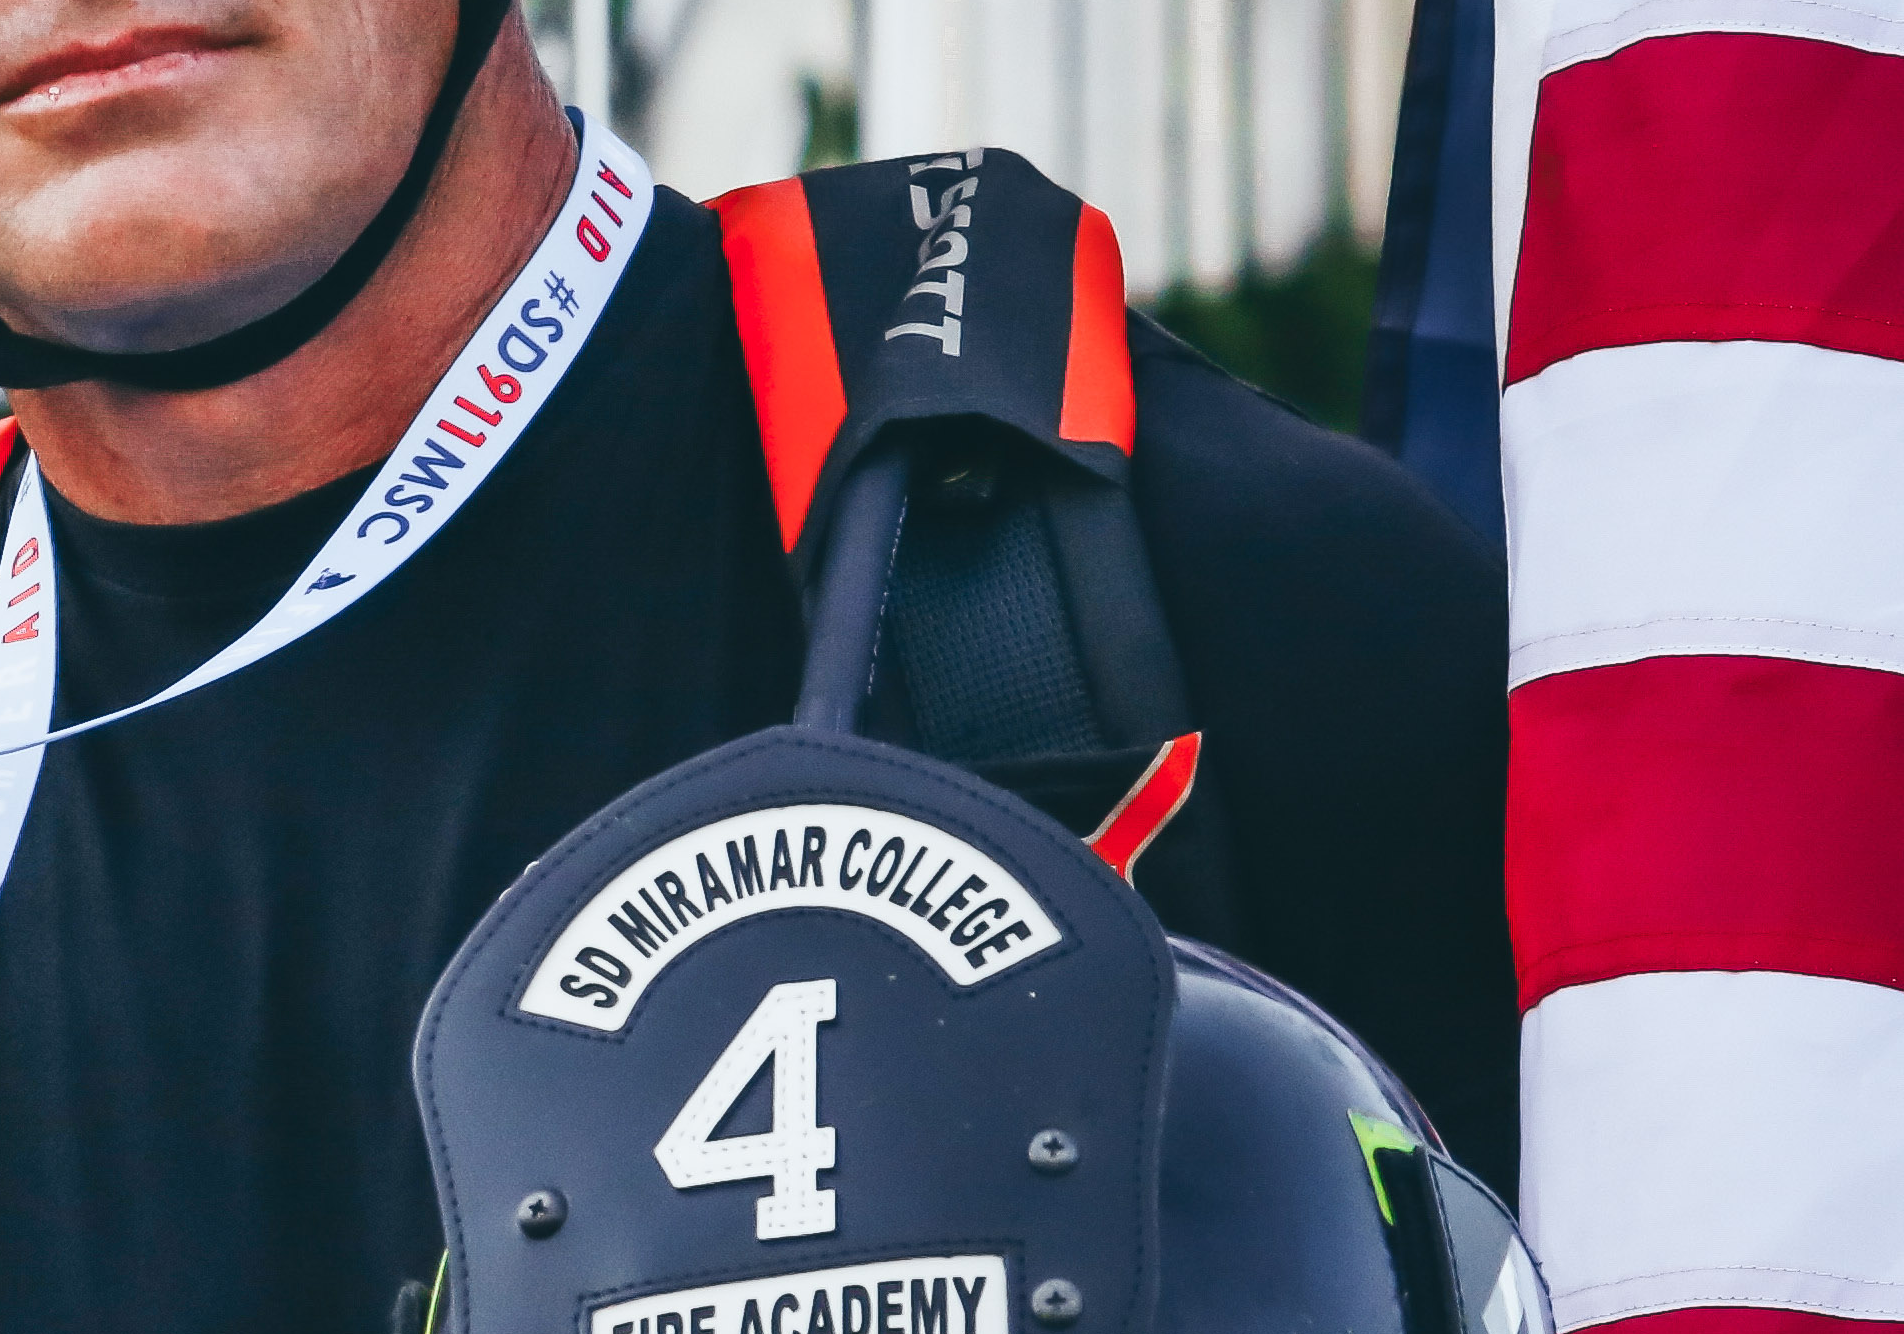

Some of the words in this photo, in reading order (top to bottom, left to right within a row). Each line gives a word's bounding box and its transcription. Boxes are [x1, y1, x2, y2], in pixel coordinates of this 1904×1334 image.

[576, 159, 635, 263] AID
[356, 268, 583, 546] #SD911MSC
[1, 535, 42, 645] AID
[559, 944, 633, 1009] SD
[607, 825, 830, 960] MIRAMAR
[839, 829, 1034, 970] COLLEGE
[653, 978, 838, 1241] 4
